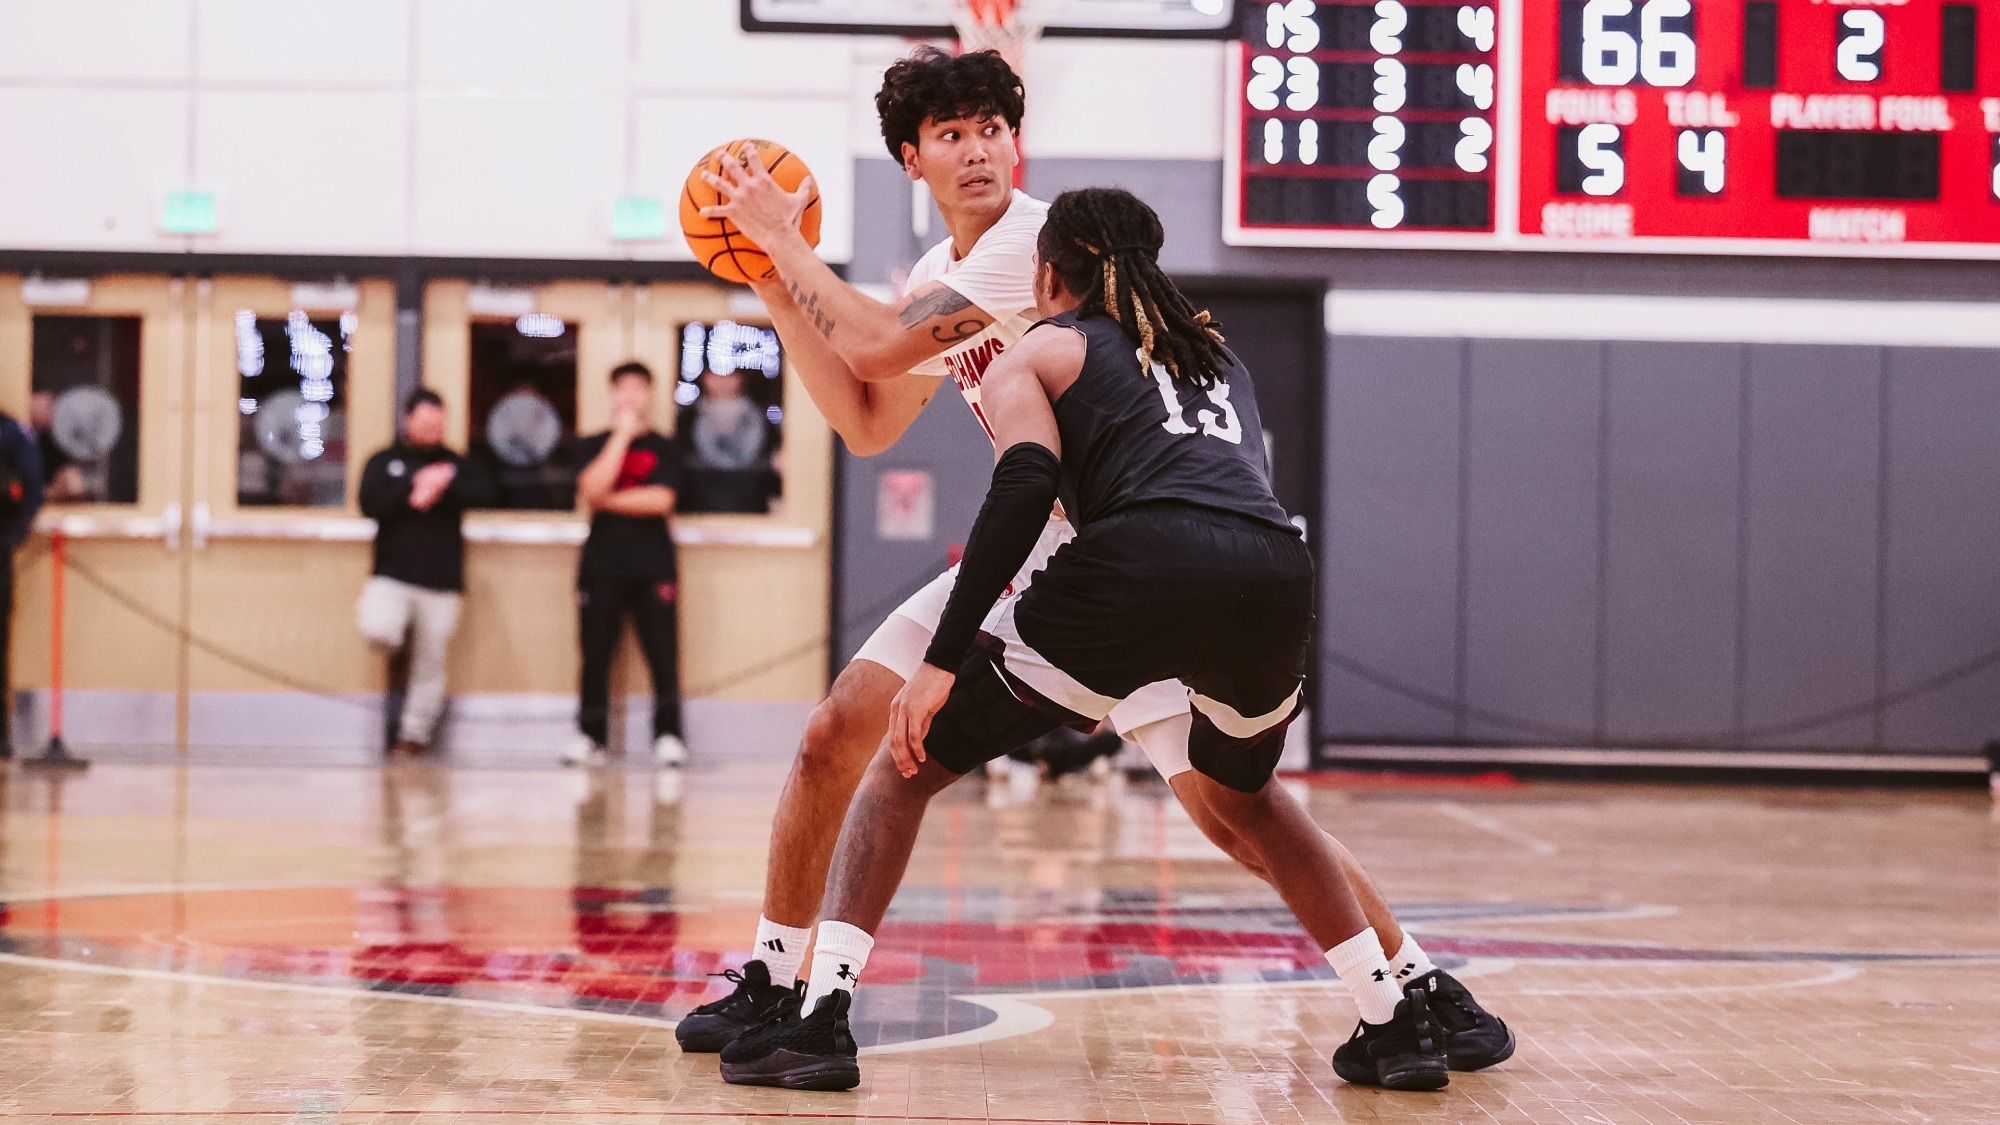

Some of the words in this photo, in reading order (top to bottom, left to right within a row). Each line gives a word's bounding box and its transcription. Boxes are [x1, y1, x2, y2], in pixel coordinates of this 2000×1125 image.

[1266, 0, 1320, 53] 15
[1370, 0, 1407, 54] 2
[1457, 5, 1494, 52] 4
[1582, 0, 1696, 86] 66
[1837, 9, 1884, 81] 2
[1247, 55, 1319, 111] 23
[1373, 57, 1406, 112] 3
[1456, 63, 1493, 110] 4
[1546, 89, 1637, 125] FOULS
[1771, 94, 1876, 129] PLAYER
[1264, 118, 1318, 165] 11
[1368, 115, 1405, 170] 2
[1455, 117, 1492, 172] 2
[1578, 124, 1624, 195] 5
[1678, 130, 1725, 193] 4
[1367, 174, 1404, 228] 5
